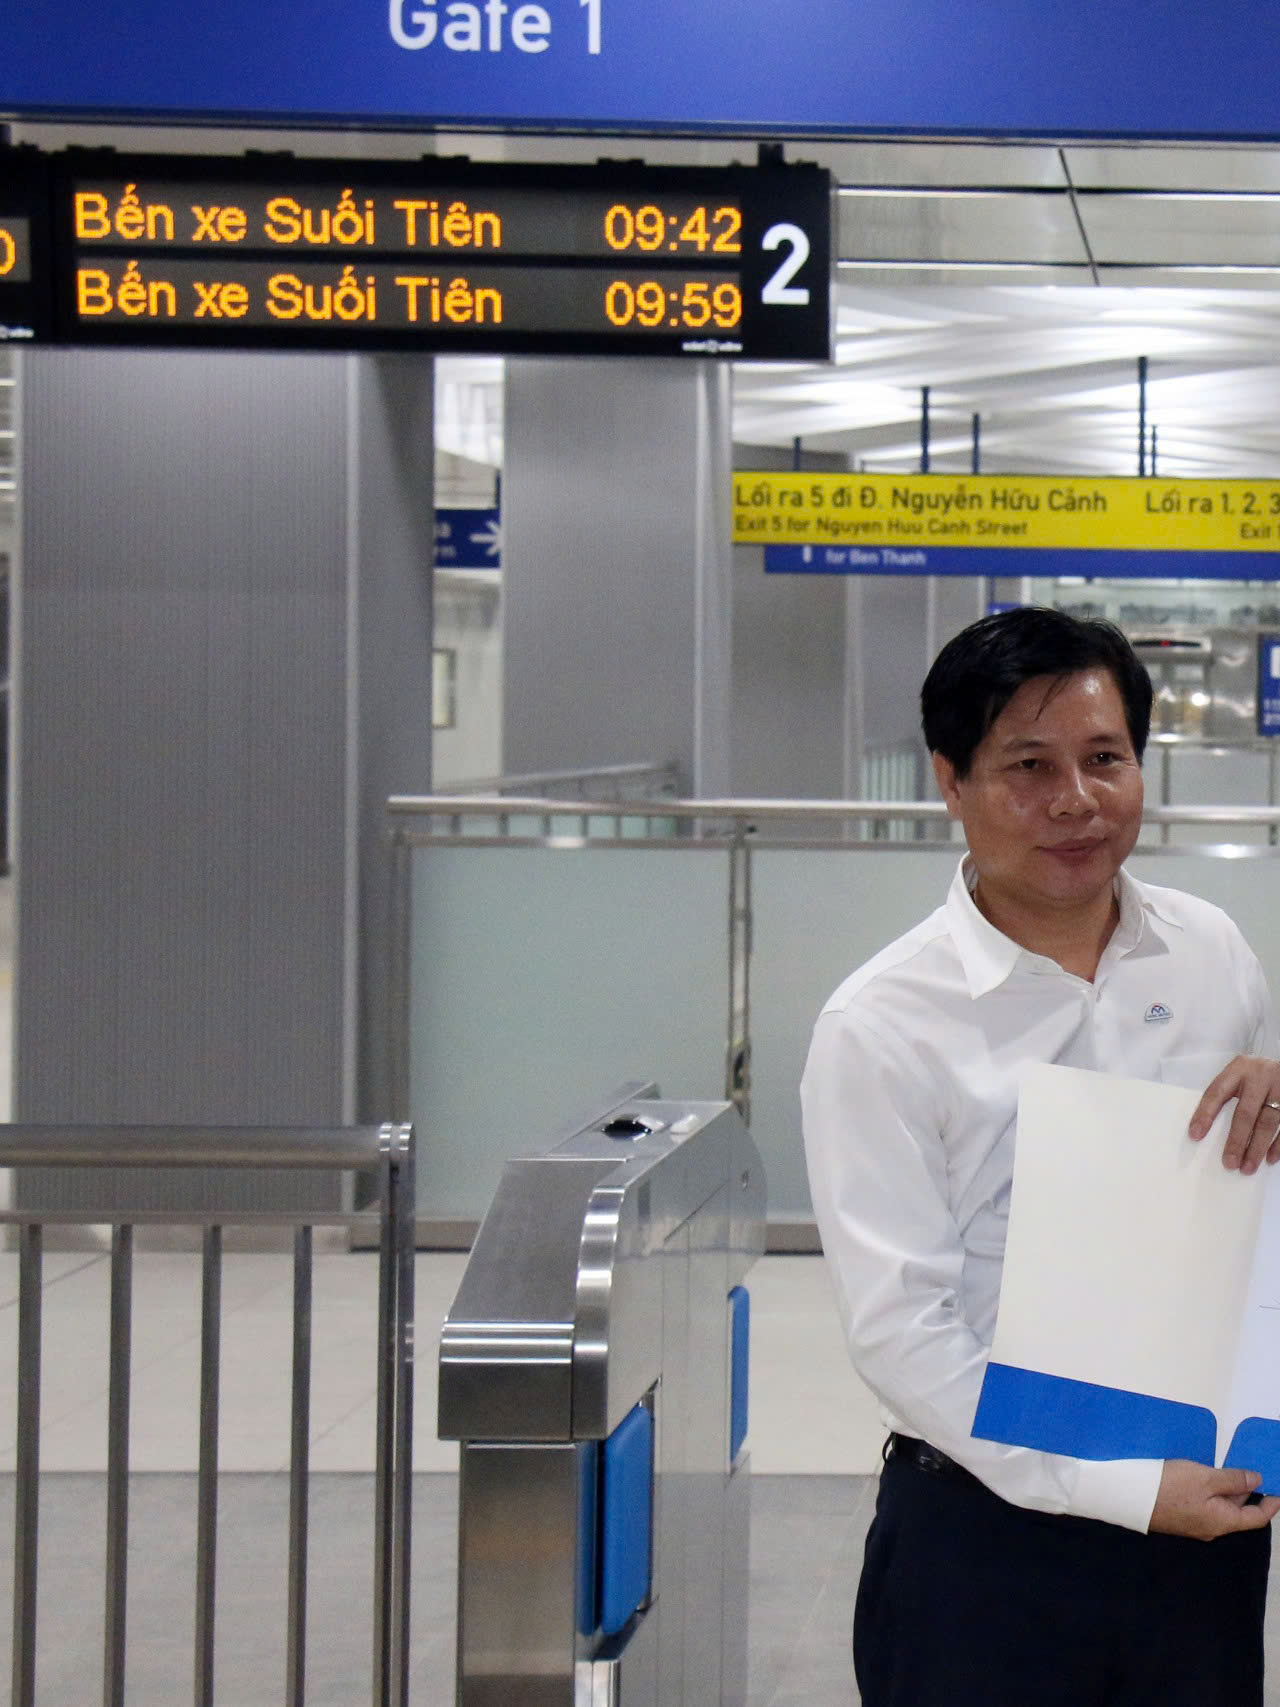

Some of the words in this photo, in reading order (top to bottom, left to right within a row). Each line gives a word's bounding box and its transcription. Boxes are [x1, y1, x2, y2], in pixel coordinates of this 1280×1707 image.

[389, 0, 551, 53] Gate
[580, 0, 601, 54] 1
[75, 183, 175, 240] Bến
[191, 205, 247, 242] xe
[264, 188, 375, 246] Suối
[394, 200, 501, 248] Tiên
[604, 204, 742, 253] 09:42
[762, 222, 810, 305] 2
[77, 260, 176, 317] Bến
[193, 282, 249, 318] xe
[266, 264, 376, 321] Suối
[395, 276, 502, 323] Tiên
[605, 281, 742, 328] 09:59
[779, 489, 803, 508] ra
[811, 485, 824, 508] 5
[832, 486, 852, 508] đi
[1189, 496, 1213, 514] ra
[735, 514, 767, 532] Exit
[787, 515, 811, 532] for
[816, 516, 882, 538] Nguyen
[887, 518, 922, 534] Huu
[927, 518, 971, 535] Canh
[976, 519, 1028, 536] Street
